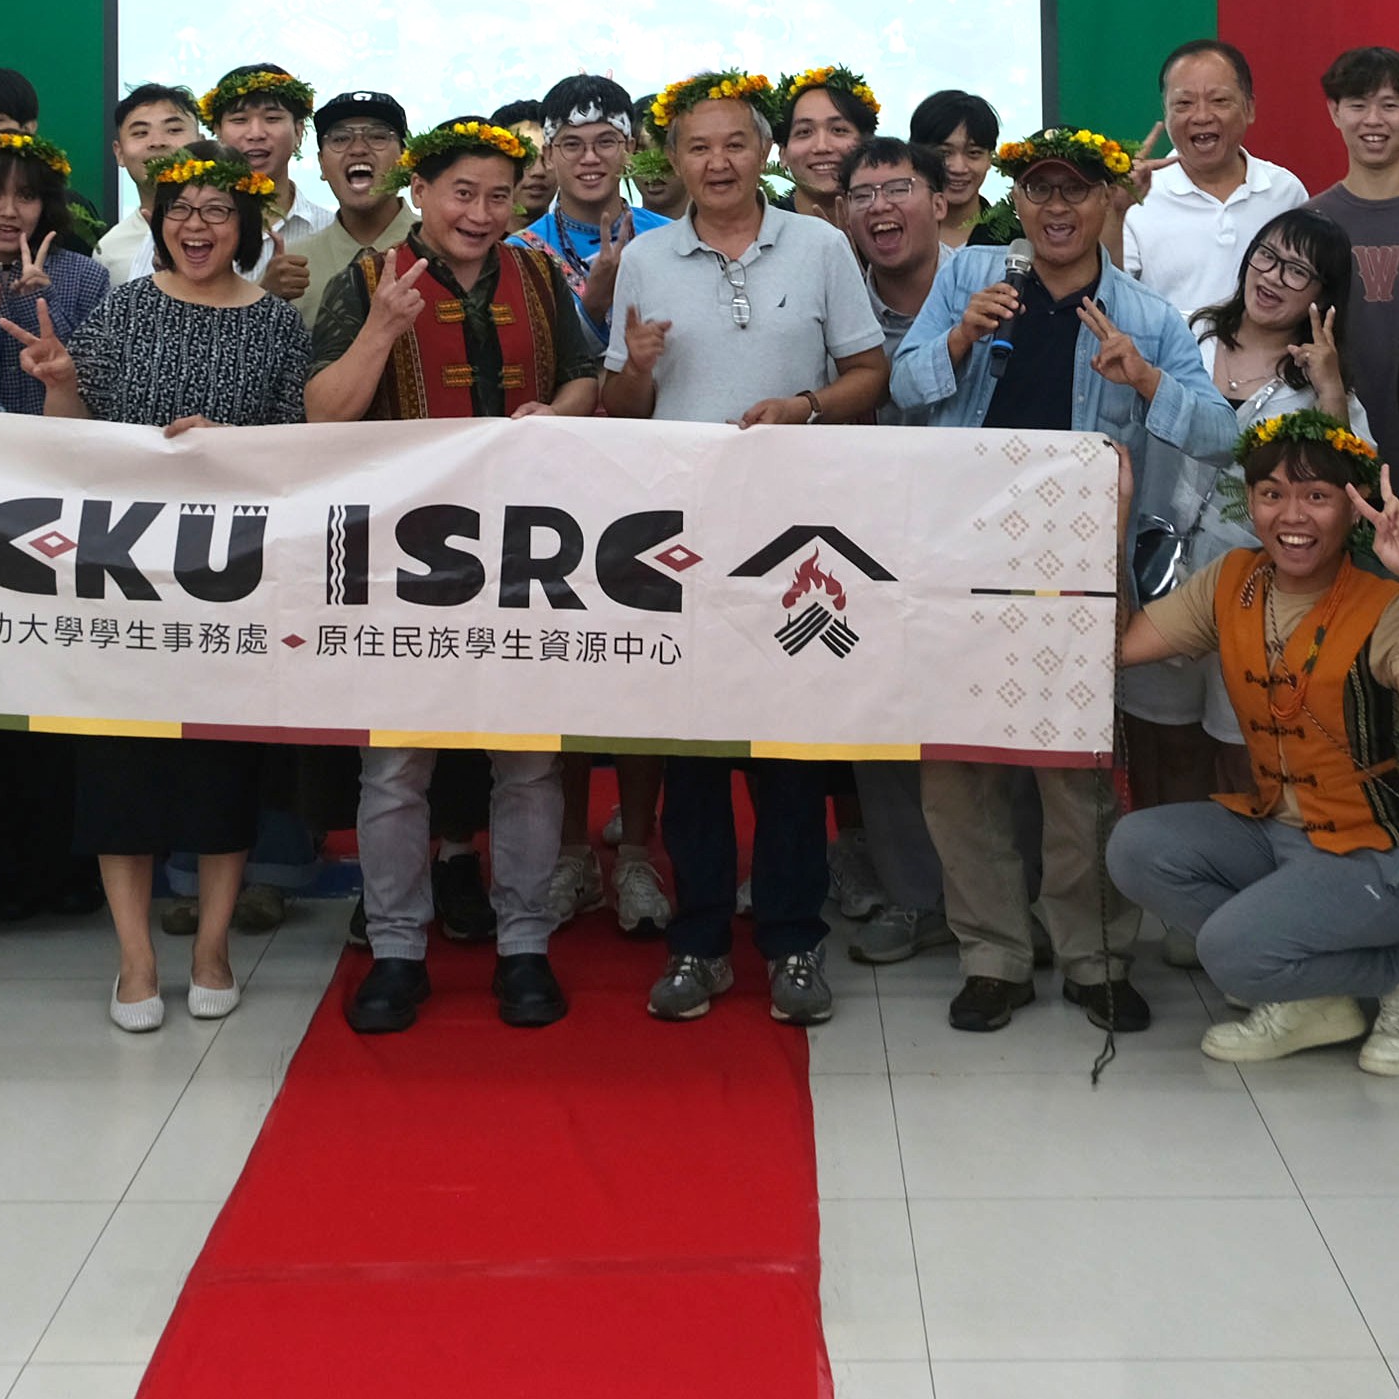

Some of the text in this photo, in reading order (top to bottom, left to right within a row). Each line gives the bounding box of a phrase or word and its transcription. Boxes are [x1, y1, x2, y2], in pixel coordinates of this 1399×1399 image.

[326, 503, 684, 613] ISRC
[316, 624, 683, 665] 原住民族學生資源中心
